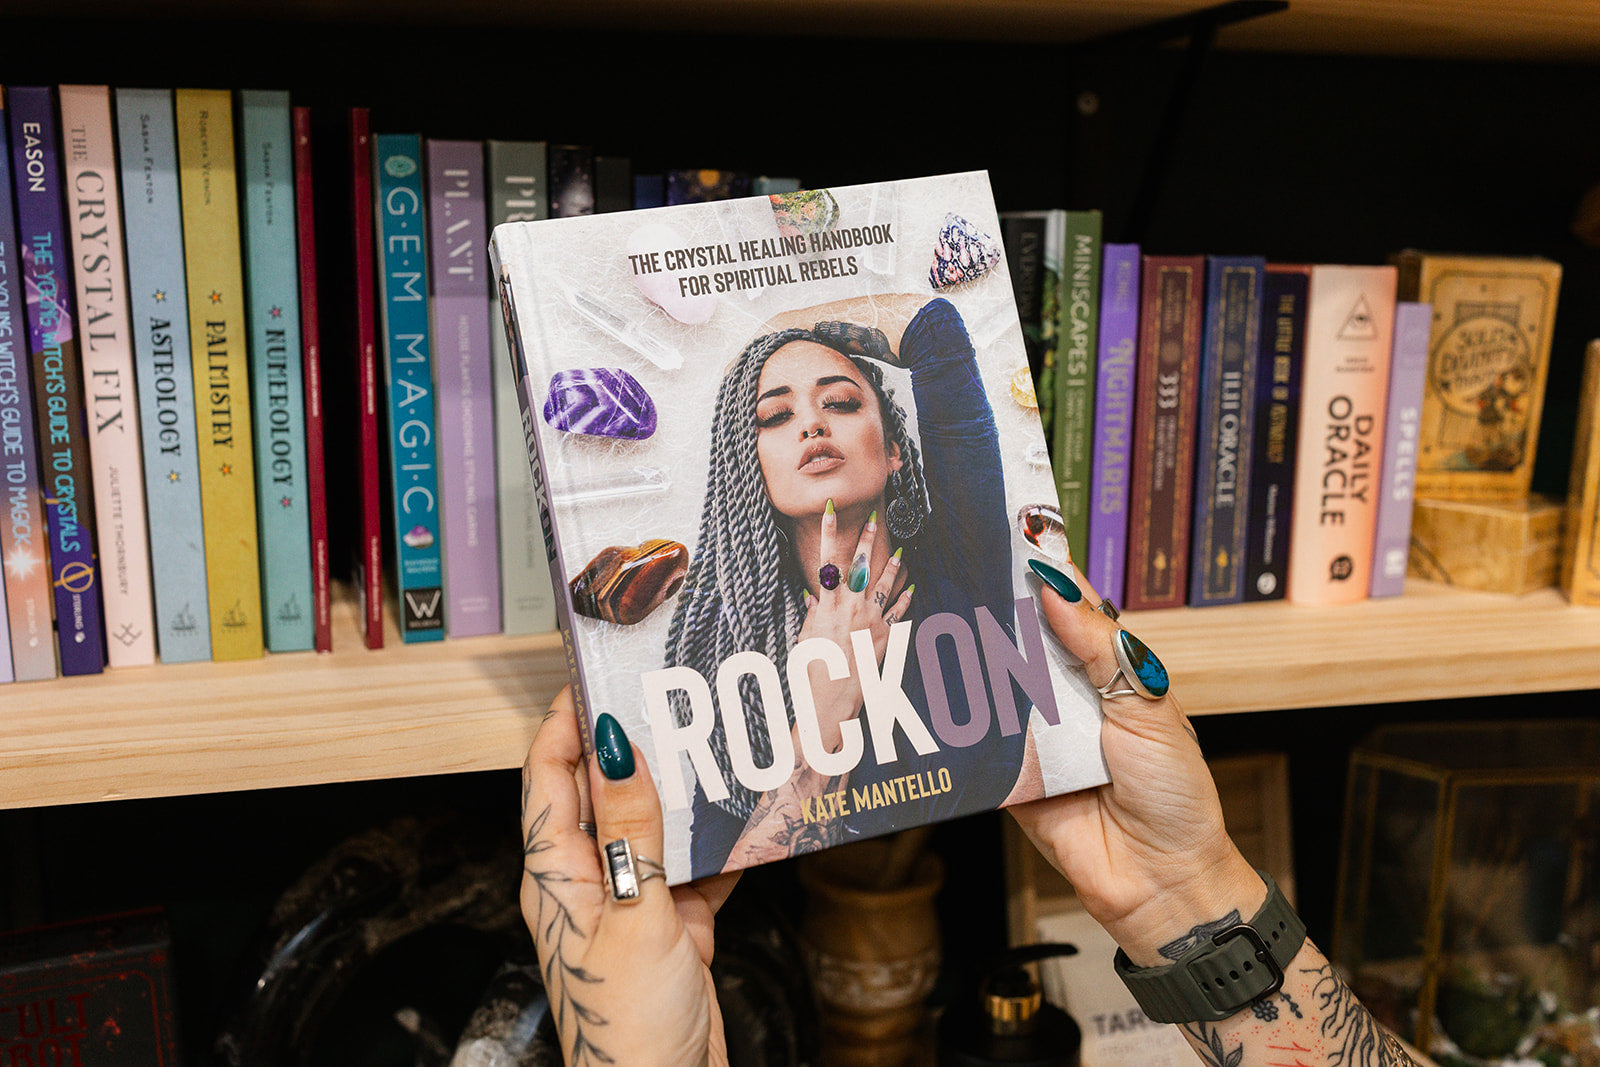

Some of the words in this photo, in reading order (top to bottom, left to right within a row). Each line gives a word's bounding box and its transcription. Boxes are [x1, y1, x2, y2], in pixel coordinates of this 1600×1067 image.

[22, 121, 46, 192] EASON
[71, 125, 88, 160] THE
[32, 231, 52, 266] THE
[444, 169, 475, 282] PLANT
[628, 252, 662, 276] THE
[664, 243, 738, 271] CRYSTAL
[738, 234, 807, 262] HEALING
[808, 224, 894, 253] HANDBOOK
[75, 170, 117, 352] CRYSTAL
[678, 275, 712, 298] FOR
[713, 264, 798, 293] SPIRITUAL
[800, 256, 859, 282] REBELS
[36, 270, 60, 327] YOUNG
[1066, 234, 1094, 377] MINISCAPES
[41, 331, 67, 393] WITCH'S
[150, 317, 182, 457] ASTROLOGY
[206, 320, 234, 449] PALMISTRY
[1156, 370, 1181, 409] 333
[1, 406, 24, 457] GUIDE
[47, 395, 70, 445] GUIDE
[92, 368, 125, 434] FIX
[266, 329, 294, 488] NUMEROLOGY
[1100, 337, 1136, 516] NIGHTMARES
[5, 460, 27, 484] TO
[52, 447, 73, 472] TO
[1215, 413, 1241, 510] ORACLE
[1319, 395, 1354, 528] ORACLE
[1349, 414, 1375, 506] DAILY
[1392, 406, 1419, 503] SPELLS
[9, 486, 32, 547] MAGICK
[54, 474, 81, 552] CRYSTALS
[563, 628, 578, 678] KATE
[799, 788, 851, 825] KATE
[851, 767, 953, 812] MANTELLO
